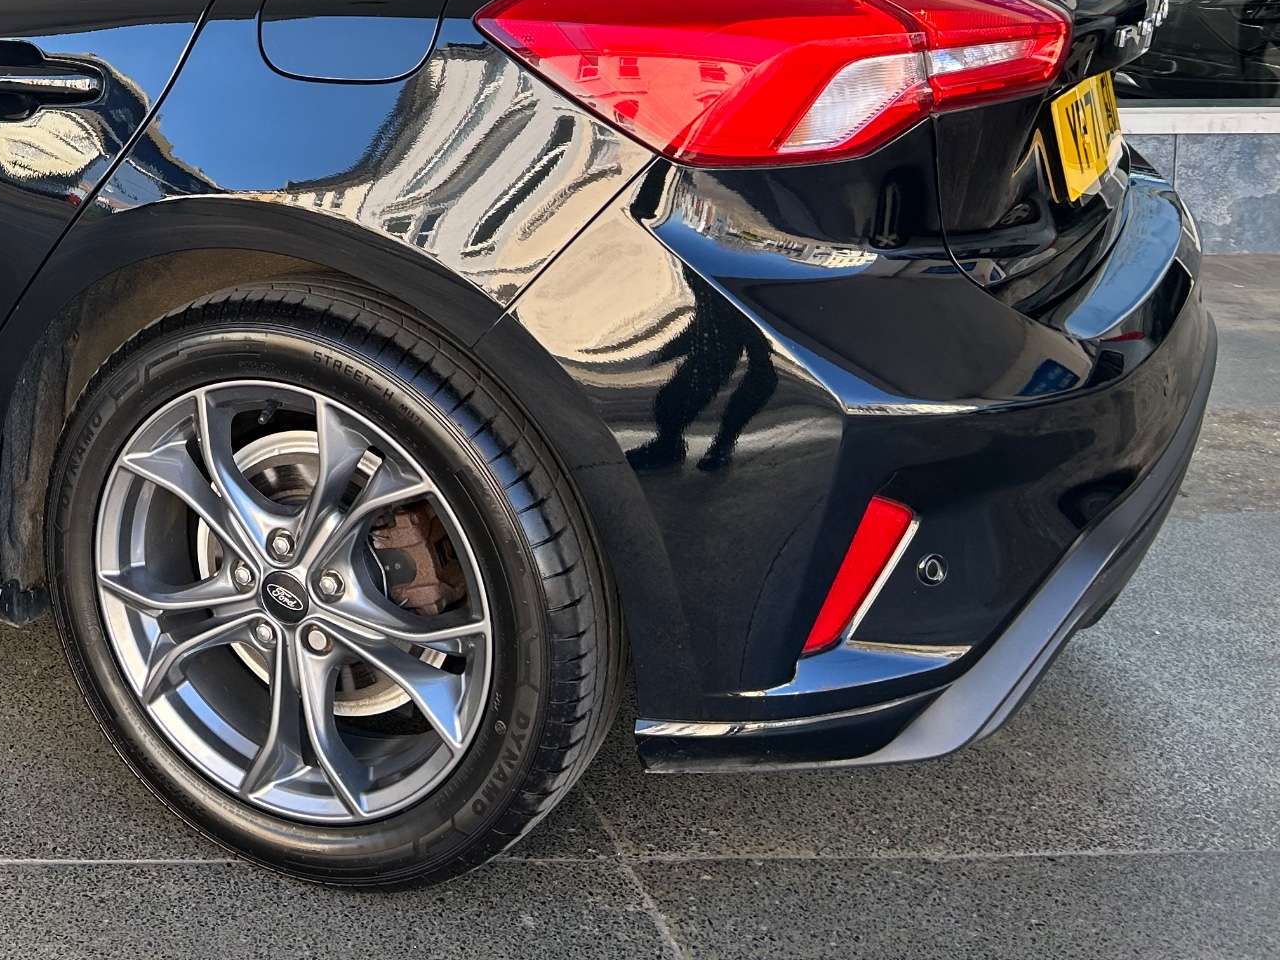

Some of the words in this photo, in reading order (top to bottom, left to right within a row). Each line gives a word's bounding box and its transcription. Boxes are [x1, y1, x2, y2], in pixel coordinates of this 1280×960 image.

[312, 350, 395, 401] STREET-H
[272, 587, 297, 608] Ford
[471, 711, 531, 815] DYNAMO
